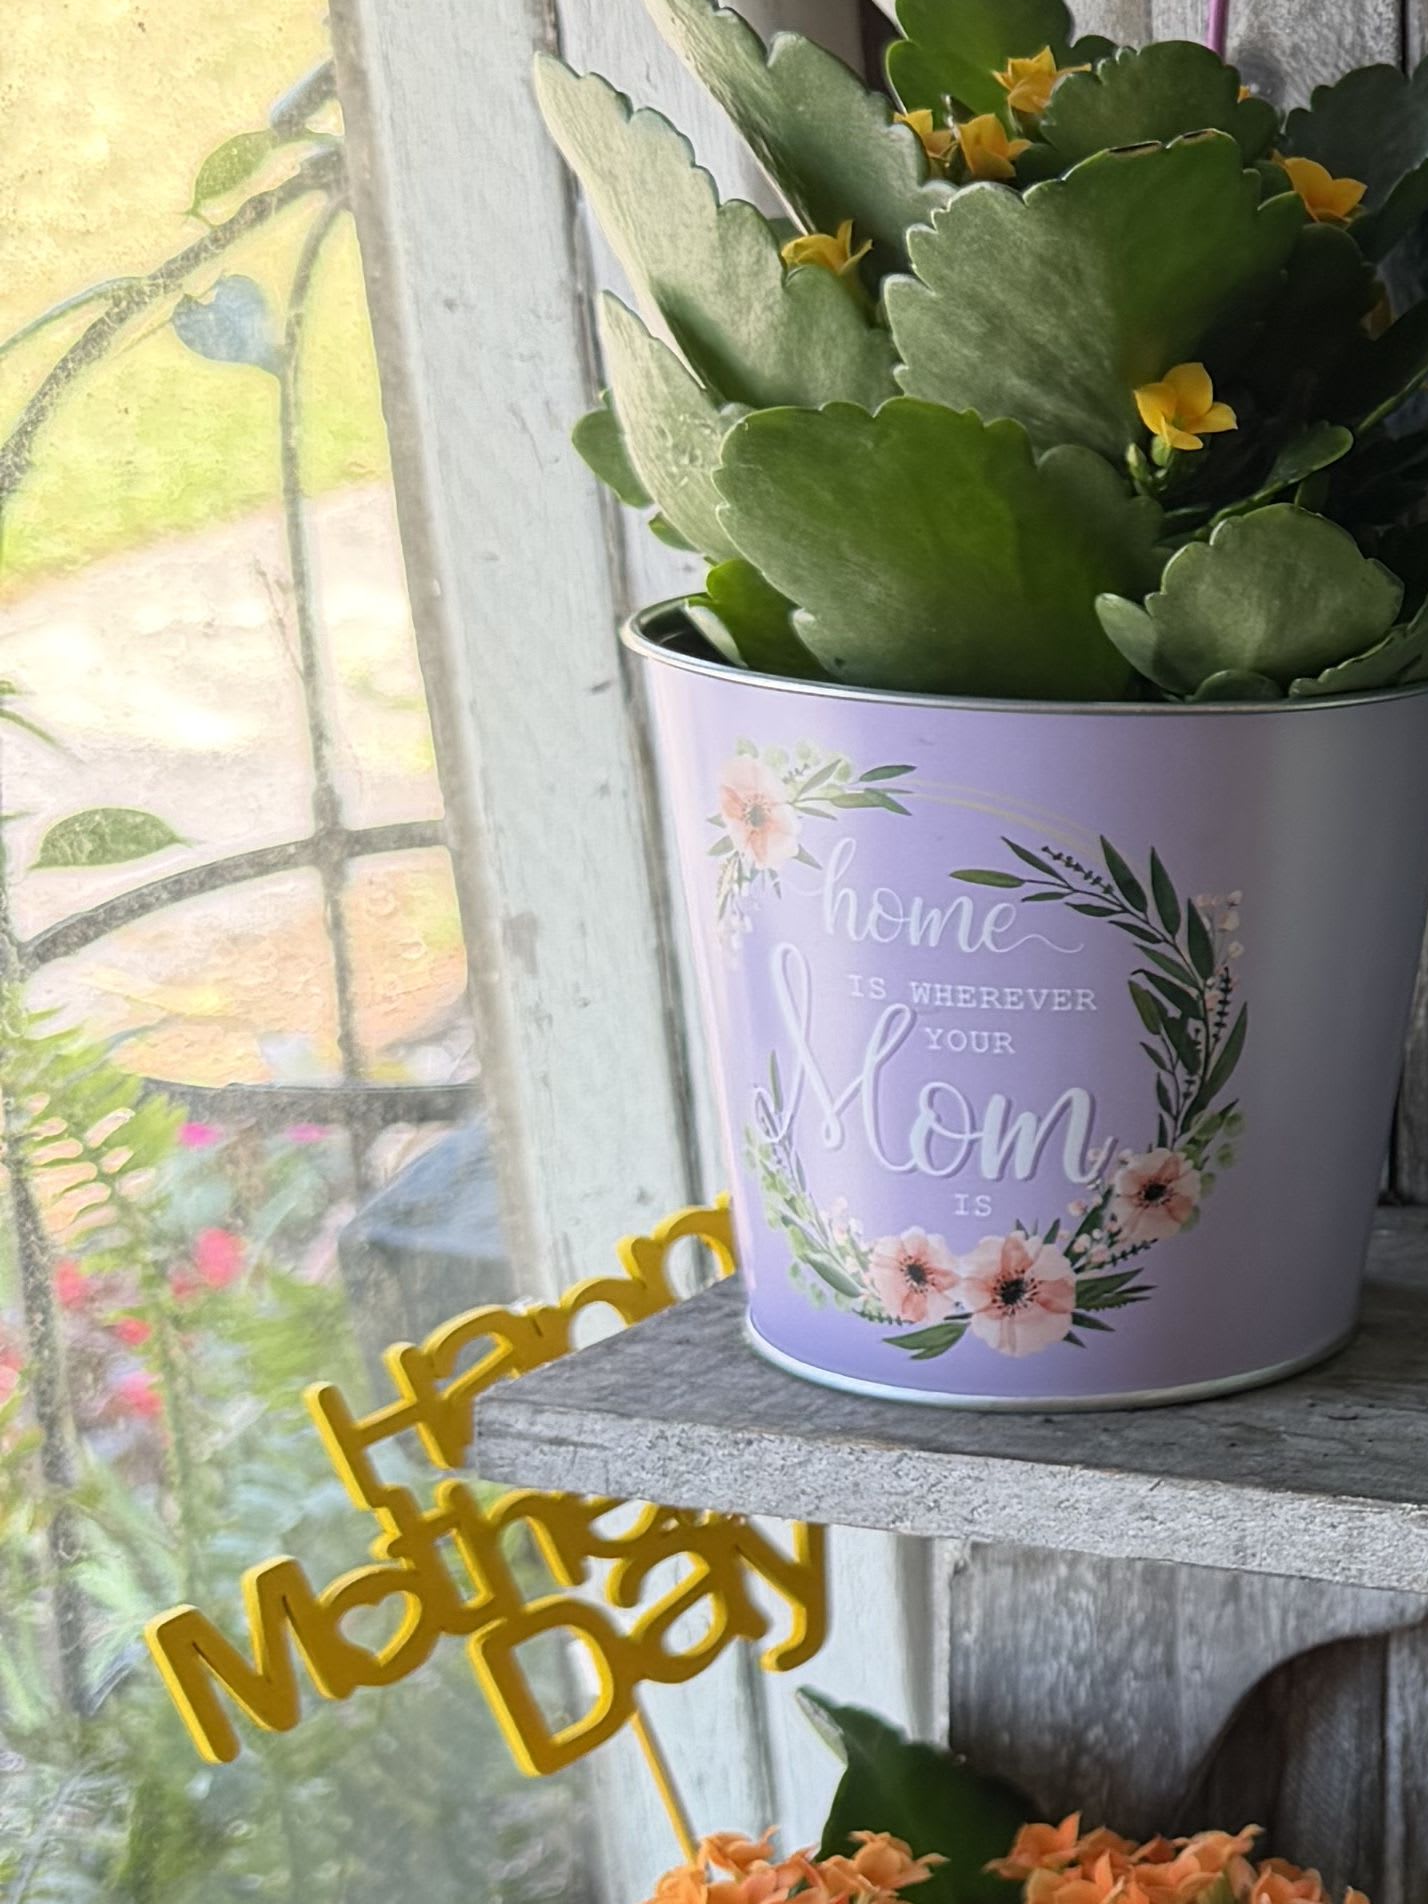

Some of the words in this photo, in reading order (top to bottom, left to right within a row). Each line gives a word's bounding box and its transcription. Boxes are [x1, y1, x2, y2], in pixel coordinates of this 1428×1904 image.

[792, 837, 1084, 953] home
[848, 974, 886, 999] IS
[909, 980, 1098, 1011] WHEREVER
[755, 942, 1119, 1184] Mom
[924, 1026, 1016, 1055] YOUR
[954, 1194, 992, 1218] IS
[468, 1508, 829, 1777] Day
